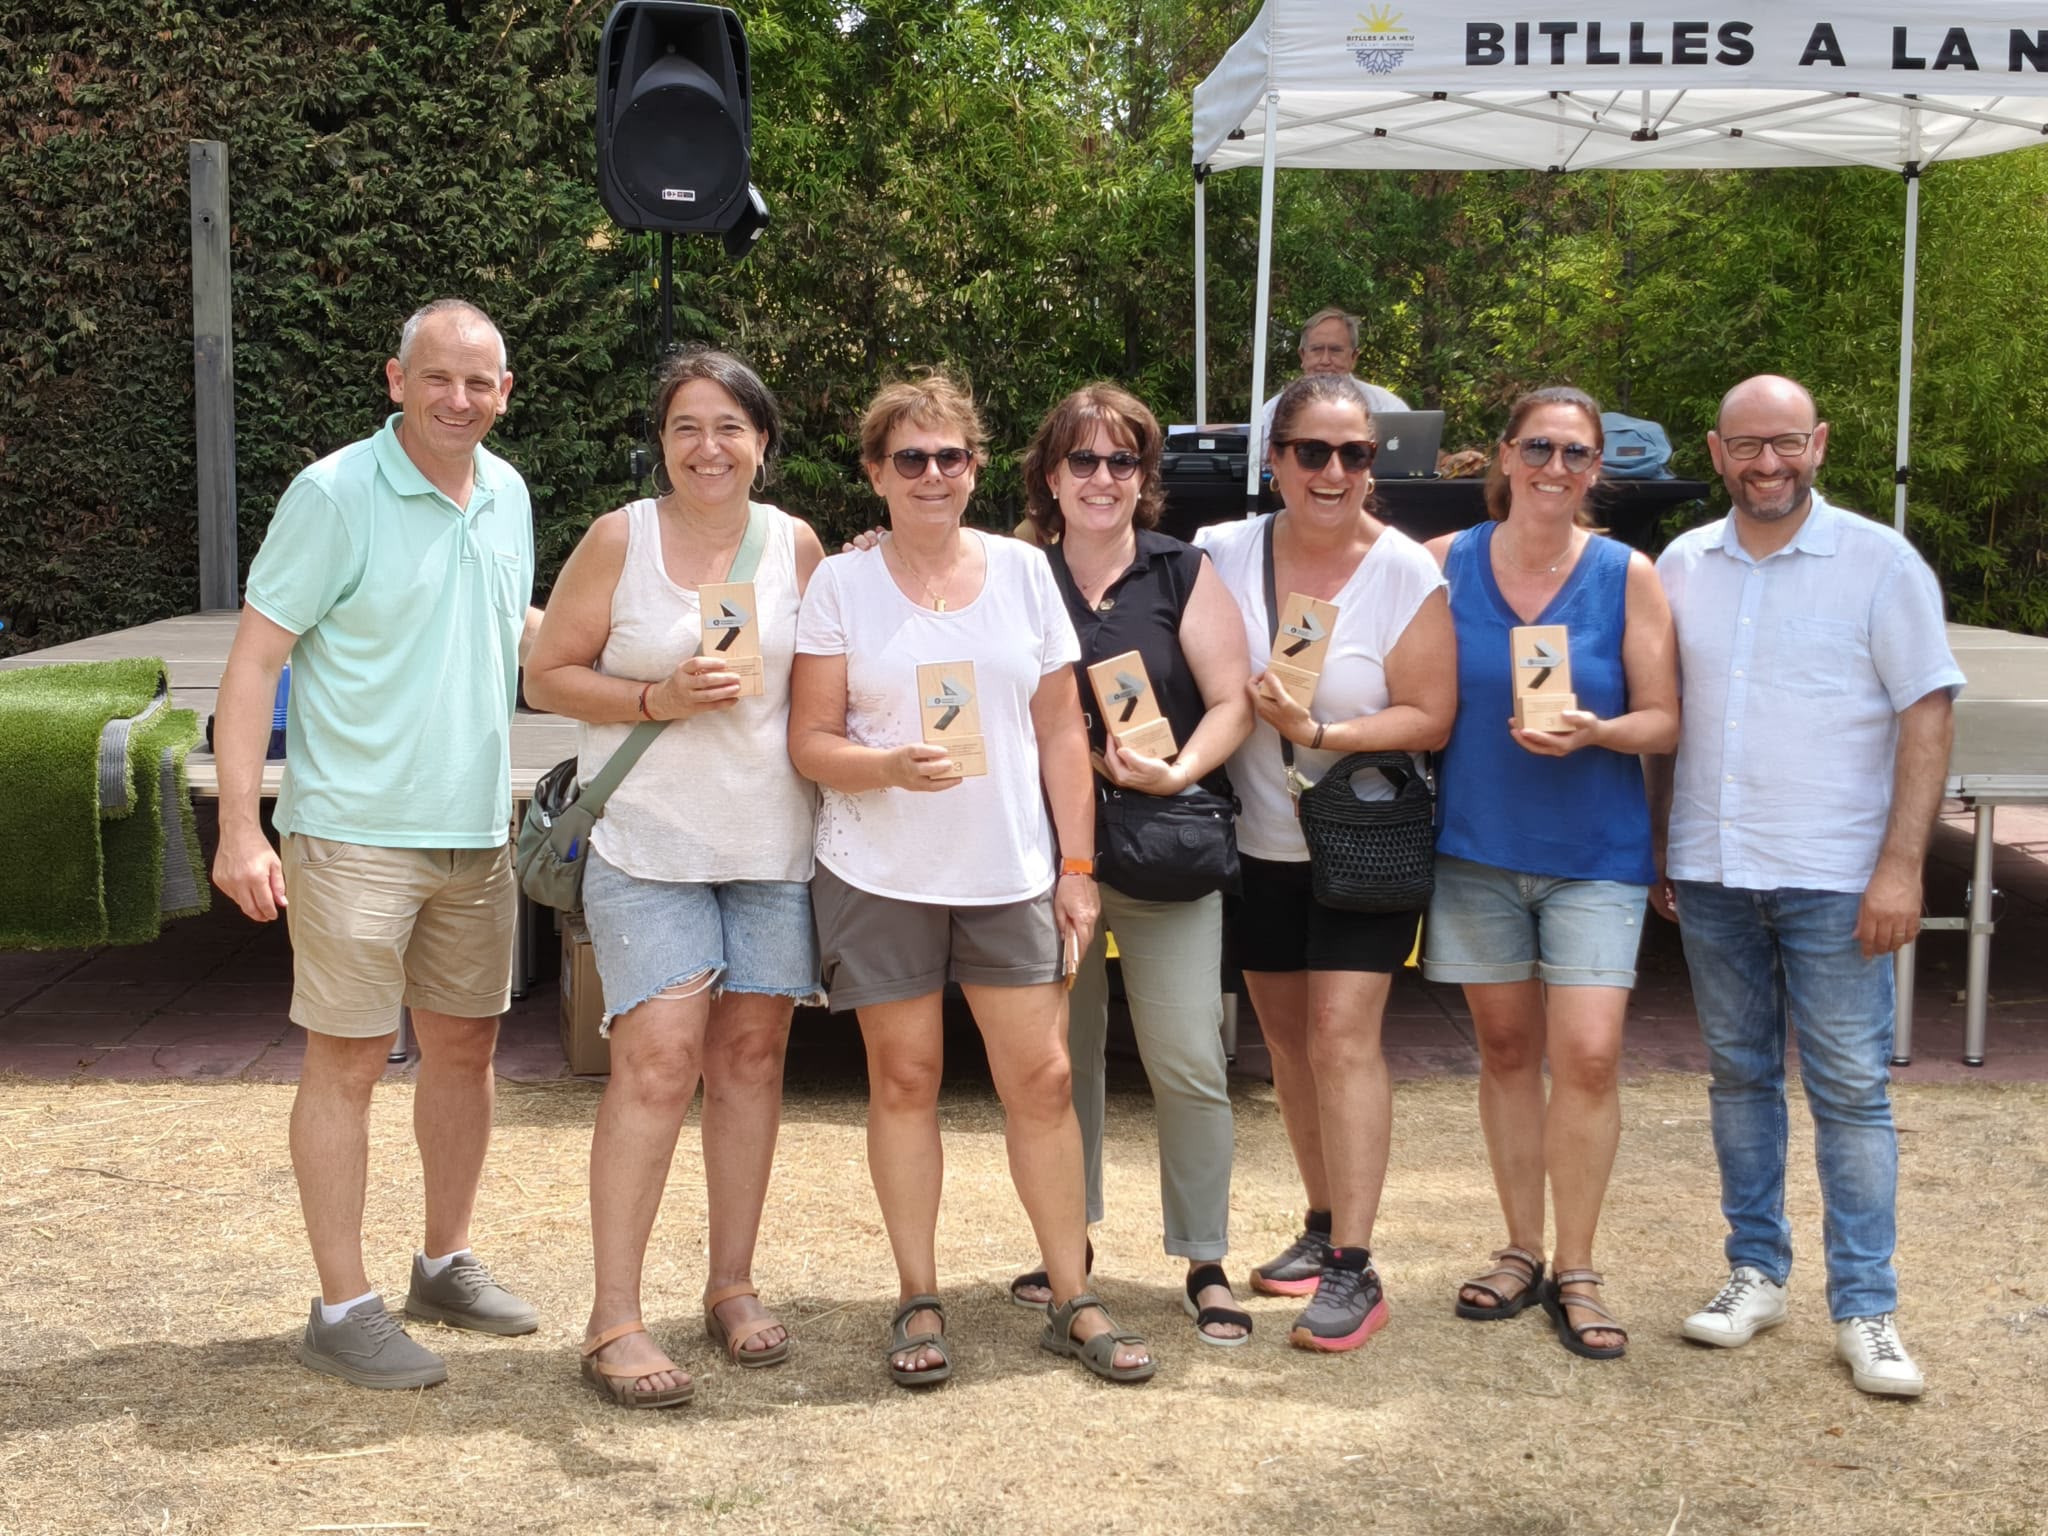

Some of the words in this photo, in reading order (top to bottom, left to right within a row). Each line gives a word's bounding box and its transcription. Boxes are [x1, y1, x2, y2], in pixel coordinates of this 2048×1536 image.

[1465, 21, 1755, 66] BITLLES
[1798, 22, 1847, 67] A
[1892, 26, 1980, 71] LA
